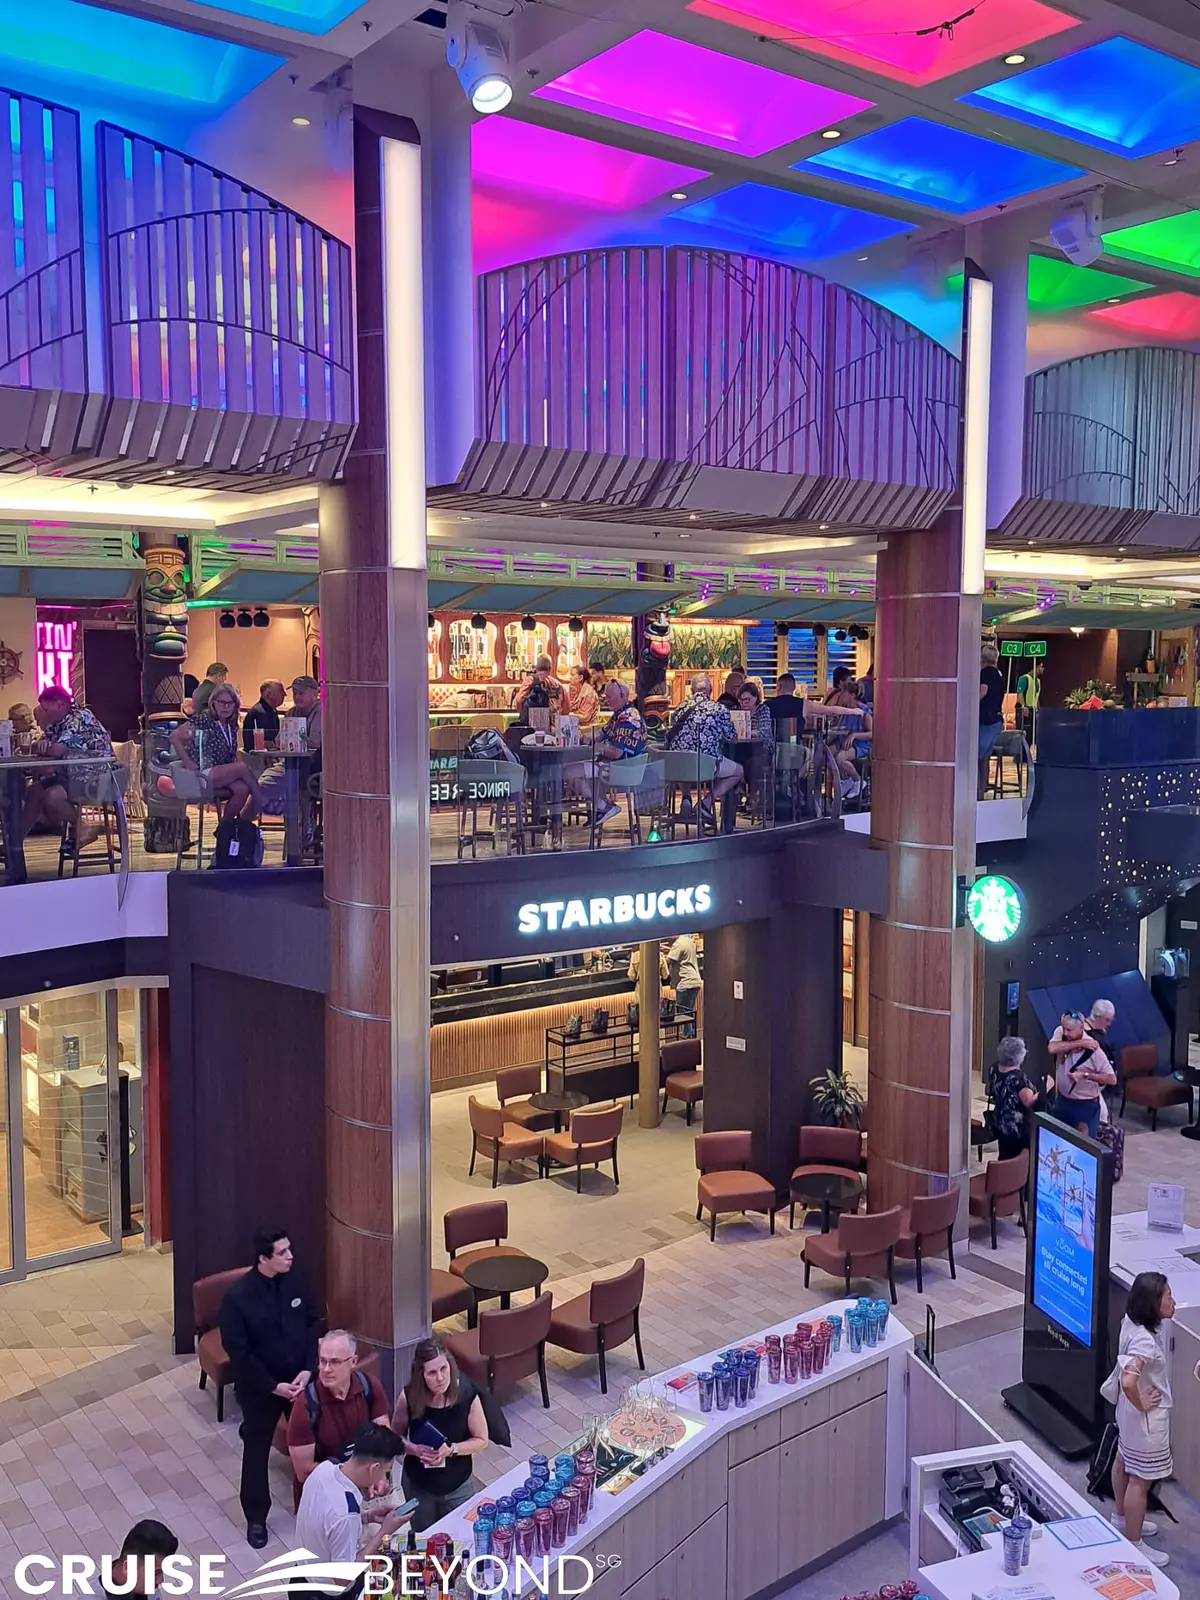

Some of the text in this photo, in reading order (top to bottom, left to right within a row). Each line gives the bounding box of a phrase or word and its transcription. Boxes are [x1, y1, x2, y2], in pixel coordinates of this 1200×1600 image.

[1007, 644, 1018, 654] C3
[1030, 644, 1041, 654] C4
[518, 884, 711, 933] STARBUCKS
[1041, 1245, 1055, 1263] Stay
[1055, 1258, 1088, 1286] connected
[1043, 1260, 1051, 1270] all
[1051, 1266, 1070, 1285] cruise
[1070, 1276, 1085, 1297] long
